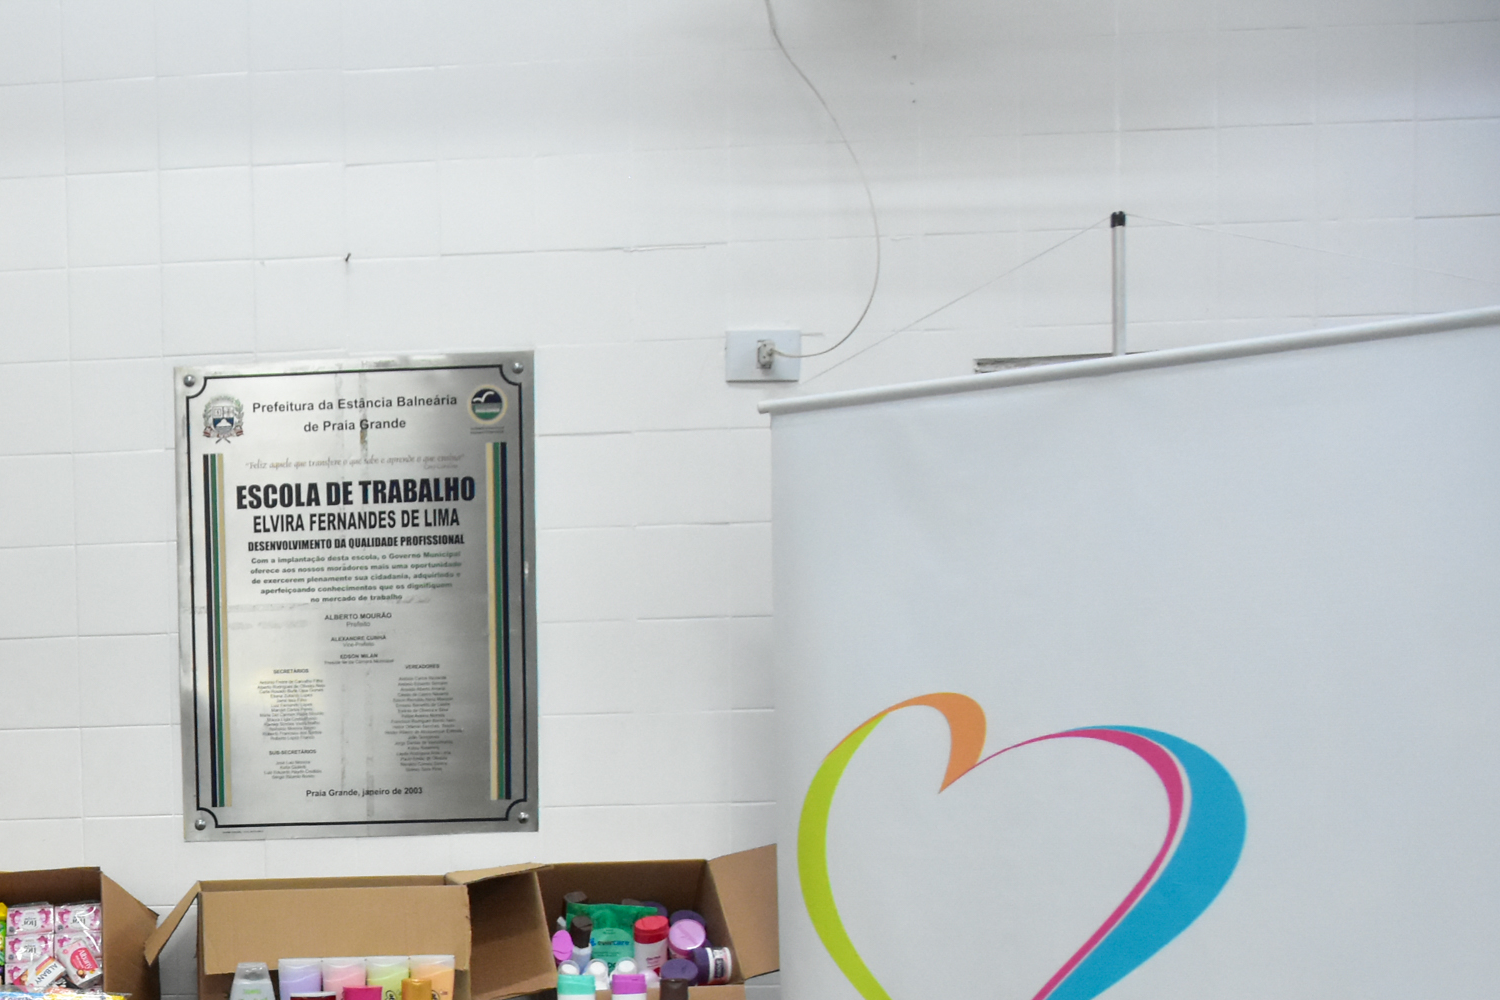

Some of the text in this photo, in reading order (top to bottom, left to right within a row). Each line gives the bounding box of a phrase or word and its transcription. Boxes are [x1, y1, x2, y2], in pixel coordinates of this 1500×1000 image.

[252, 394, 458, 413] Prefeitura da Estância Balneária
[303, 418, 407, 433] de Praia Grande
[236, 476, 476, 509] ESCOLA DE TRABALHO
[253, 508, 460, 533] ELVIRA FERNANDES DE LIMA
[248, 534, 465, 552] DESENVOLVIMENTO DA QUALIDADE PROFISSIONAL
[277, 555, 325, 564] implantação
[327, 554, 349, 562] desta
[389, 552, 421, 560] Governo
[423, 551, 461, 560] Municipal
[410, 561, 462, 570] oportunidade
[307, 575, 352, 584] plenamente
[370, 573, 411, 581] cidadania,
[413, 572, 454, 581] adquirindo
[260, 586, 316, 595] aperfeiçoando
[317, 584, 377, 592] conhecimentos
[407, 582, 453, 591] dignifiquem
[370, 593, 403, 601] trabalho
[324, 611, 392, 621] ALBERTO MOURÃO
[306, 786, 423, 798] Praia Grande, janeiro de 2003
[35, 963, 59, 985] ALBANY
